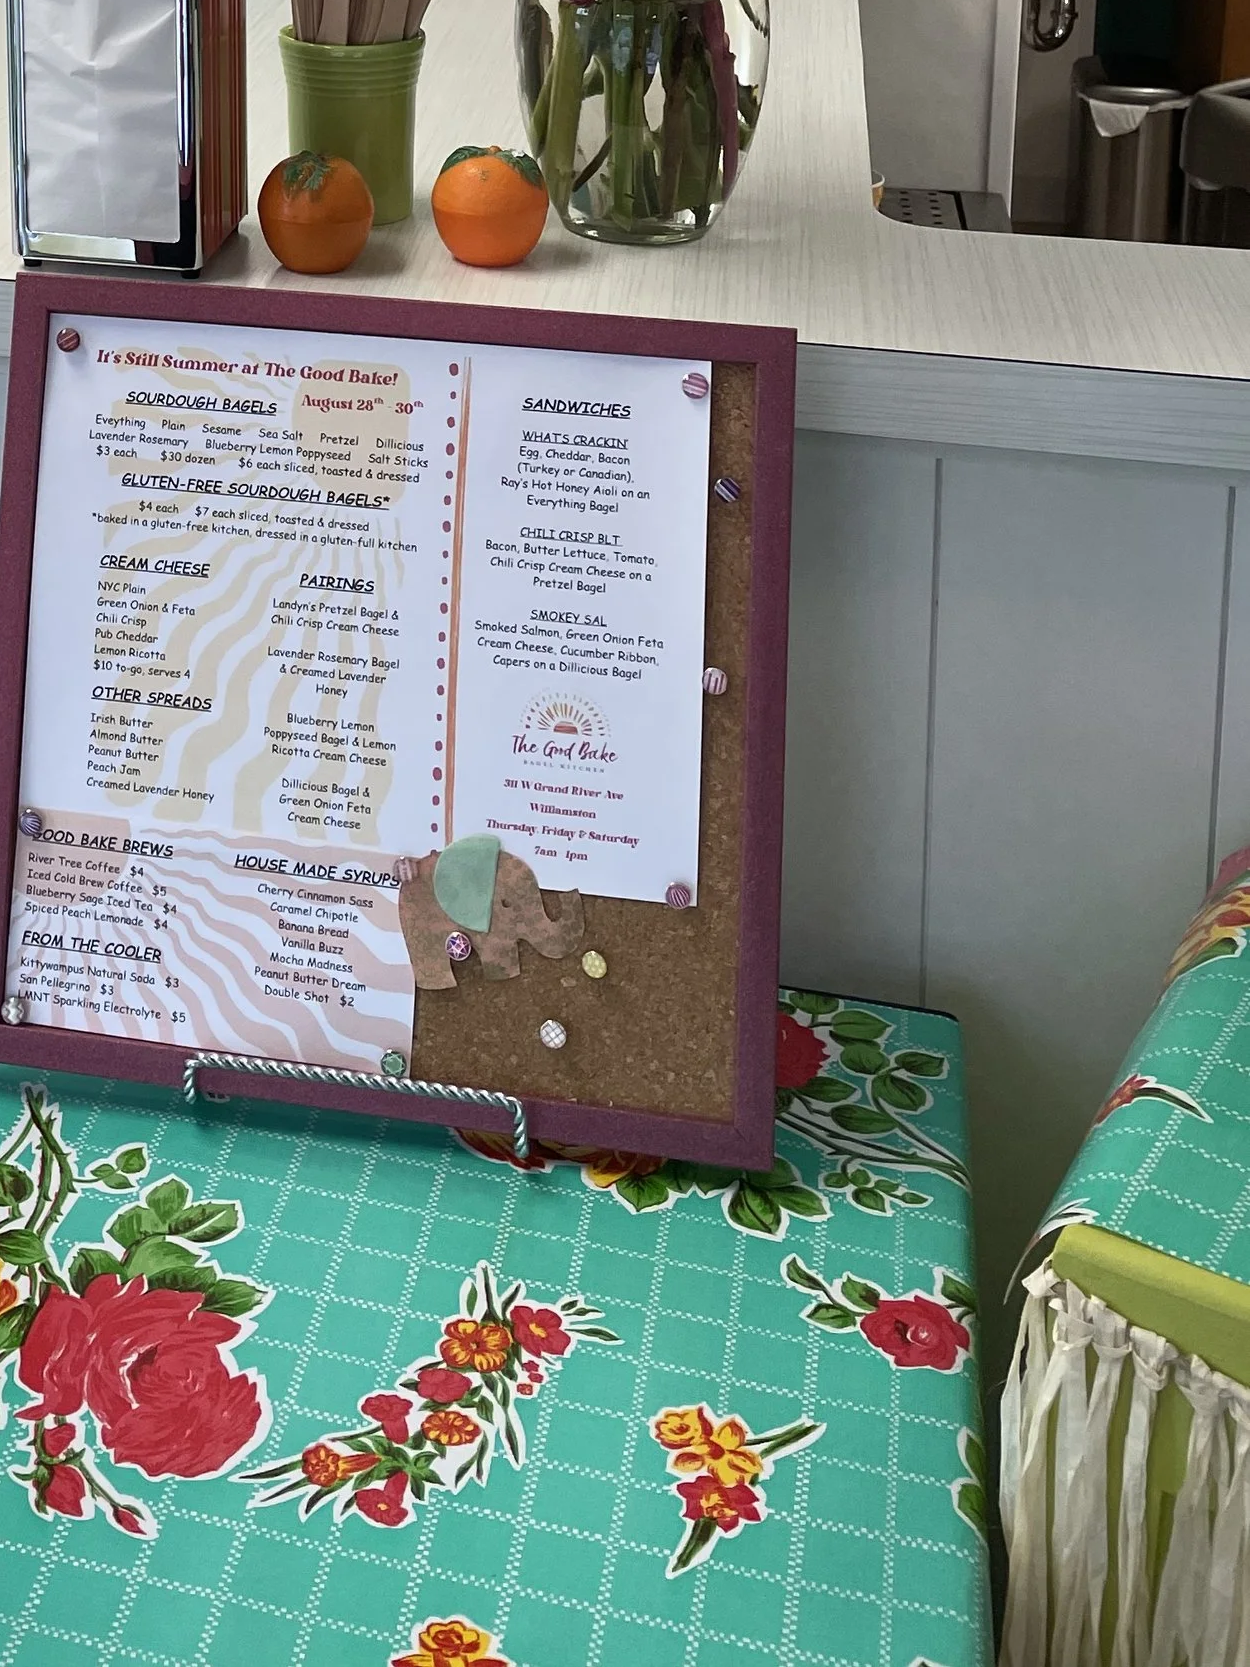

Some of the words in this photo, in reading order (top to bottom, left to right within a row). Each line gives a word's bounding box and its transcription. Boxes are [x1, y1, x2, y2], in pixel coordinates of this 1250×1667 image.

[96, 349, 122, 364] It's
[124, 351, 160, 367] Still
[161, 354, 239, 374] Summer
[241, 363, 259, 375] at
[264, 362, 296, 378] The
[299, 365, 345, 382] Good
[348, 369, 399, 386] Bake!
[125, 390, 218, 410] SOURDOUGH
[222, 398, 278, 414] BAGELS
[301, 394, 353, 414] August
[522, 397, 632, 418] SANDWICHES
[95, 413, 146, 431] Eveything
[161, 419, 186, 431] Plain
[201, 423, 242, 436] Sesame
[258, 427, 279, 440] Sea
[281, 429, 303, 441] Salt
[319, 432, 359, 446] Pretzel
[375, 437, 424, 452] Dillicious
[89, 429, 136, 442] Lavender
[138, 433, 189, 450] Rosemary
[205, 438, 257, 456] Blueberry
[259, 443, 294, 456] Lemon
[295, 446, 352, 462] Poppyseed
[367, 453, 391, 465] Salt
[393, 455, 429, 468] Sticks
[121, 472, 223, 494] GLUTEN-FREE
[226, 482, 322, 502] SOURDOUGH
[500, 476, 529, 491] Ray's
[531, 478, 553, 491] Hot
[555, 481, 590, 497] Honey
[593, 485, 618, 496] Aioli
[621, 489, 634, 498] on
[636, 491, 650, 500] an
[526, 494, 586, 513] Everything
[589, 500, 619, 515] Bagel
[520, 526, 555, 539] CHILI
[557, 529, 594, 543] CRISP
[597, 533, 620, 546] BLT
[100, 554, 149, 571] CREAM
[154, 559, 211, 577] CHEESE
[97, 580, 121, 592] NYC
[122, 582, 146, 595] Plain
[299, 573, 375, 593] PAIRINGS
[532, 576, 573, 590] Pretzel
[576, 580, 606, 596] Bagel
[96, 596, 128, 609] Green
[129, 599, 159, 612] Onion
[161, 602, 169, 614] &
[171, 603, 196, 616] Feta
[272, 597, 317, 614] Landyn's
[318, 602, 357, 616] Pretzel
[360, 606, 389, 622] Bagel
[391, 610, 399, 621] &
[530, 609, 580, 624] SMOKEY
[584, 614, 608, 626] SAL
[95, 612, 118, 624] Chili
[120, 614, 147, 630] Crisp
[270, 614, 294, 626] Chili
[296, 616, 324, 631] Crisp
[325, 619, 359, 632] Cream
[361, 623, 399, 637] Cheese
[94, 627, 113, 640] Pub
[115, 630, 159, 644] Cheddar
[474, 619, 518, 634] Smoked
[565, 628, 600, 642] Green
[602, 632, 635, 646] Onion
[637, 635, 664, 649] Feta
[93, 643, 127, 657] Lemon
[128, 647, 166, 661] Ricotta
[493, 654, 531, 669] Capers
[533, 661, 547, 670] on
[548, 662, 556, 671] a
[559, 660, 609, 676] Dillicious
[612, 666, 642, 682] Bagel
[92, 685, 142, 702] OTHER
[146, 691, 212, 710] SPREADS
[90, 712, 116, 725] Irish
[119, 715, 154, 729] Butter
[89, 728, 127, 742] Almond
[129, 732, 164, 746] Butter
[512, 733, 538, 755] The
[543, 740, 576, 761] Good
[578, 741, 617, 763] Bake
[88, 743, 122, 758] Peanut
[125, 748, 160, 762] Butter
[87, 759, 117, 774] Peach
[119, 763, 141, 776] Jam
[86, 776, 131, 791] Creamed
[133, 781, 180, 797] Lavender
[182, 787, 215, 804] Honey
[520, 780, 531, 790] W
[533, 782, 569, 795] Grand
[571, 785, 602, 798] River
[529, 802, 596, 819] Williamston
[79, 832, 118, 850] BAKE
[121, 838, 174, 857] BREWS
[28, 852, 56, 865] River
[58, 855, 83, 869] Tree
[85, 860, 121, 875] Coffee
[129, 865, 144, 879] $4
[234, 853, 288, 873] HOUSE
[292, 860, 338, 880] MADE
[341, 867, 400, 888] SYRUPS
[27, 868, 52, 881] Iced
[53, 872, 76, 885] Cold
[78, 874, 105, 889] Brew
[107, 879, 143, 894] Coffee
[151, 884, 167, 898] $5
[257, 883, 294, 900] Cherry
[296, 888, 346, 905] Cinnamon
[348, 895, 374, 909] Sass
[24, 901, 60, 915] Spiced
[61, 905, 91, 919] Peach
[93, 909, 144, 927] Lemonade
[153, 918, 168, 931] $4
[270, 901, 313, 917] Caramel
[315, 907, 359, 923] Chipotle
[278, 918, 315, 934] Banana
[317, 924, 350, 939] Bread
[21, 929, 64, 948] FROM
[69, 936, 100, 954] THE
[103, 941, 162, 963] COOLER
[281, 936, 316, 951] Vanilla
[318, 941, 344, 956] Buzz
[20, 956, 85, 976] Kittywampus
[87, 965, 127, 981] Natural
[129, 972, 156, 985] Soda
[164, 975, 180, 989] $3
[269, 951, 304, 966] Mocha
[306, 957, 353, 974] Madness
[19, 973, 38, 985] San
[40, 975, 91, 993] Pellegrino
[99, 983, 114, 996] $3
[254, 965, 289, 981] Peanut
[292, 971, 329, 987] Butter
[331, 977, 367, 992] Dream
[264, 984, 300, 1000] Double
[303, 990, 330, 1004] Shot
[339, 994, 355, 1008] $2
